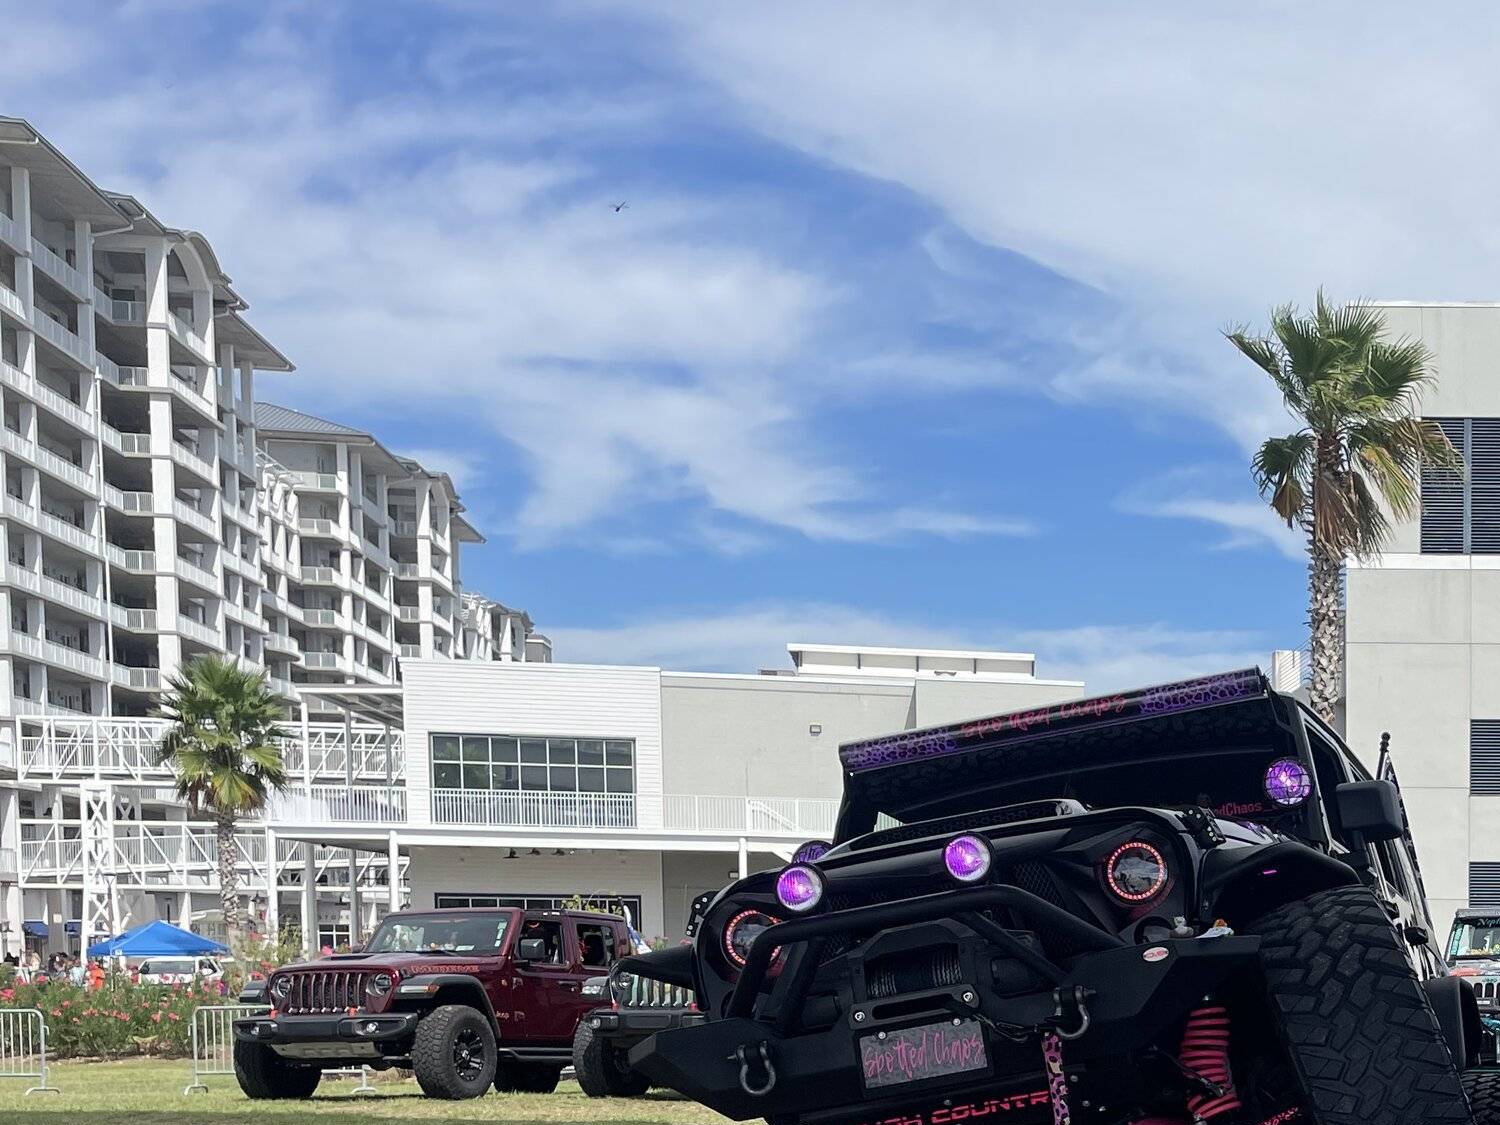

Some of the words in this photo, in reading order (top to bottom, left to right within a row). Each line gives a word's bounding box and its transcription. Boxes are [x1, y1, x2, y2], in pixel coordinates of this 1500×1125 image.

[864, 1031, 928, 1084] Spotted
[932, 1030, 985, 1068] Chaos
[930, 1090, 1050, 1125] COUNTR
